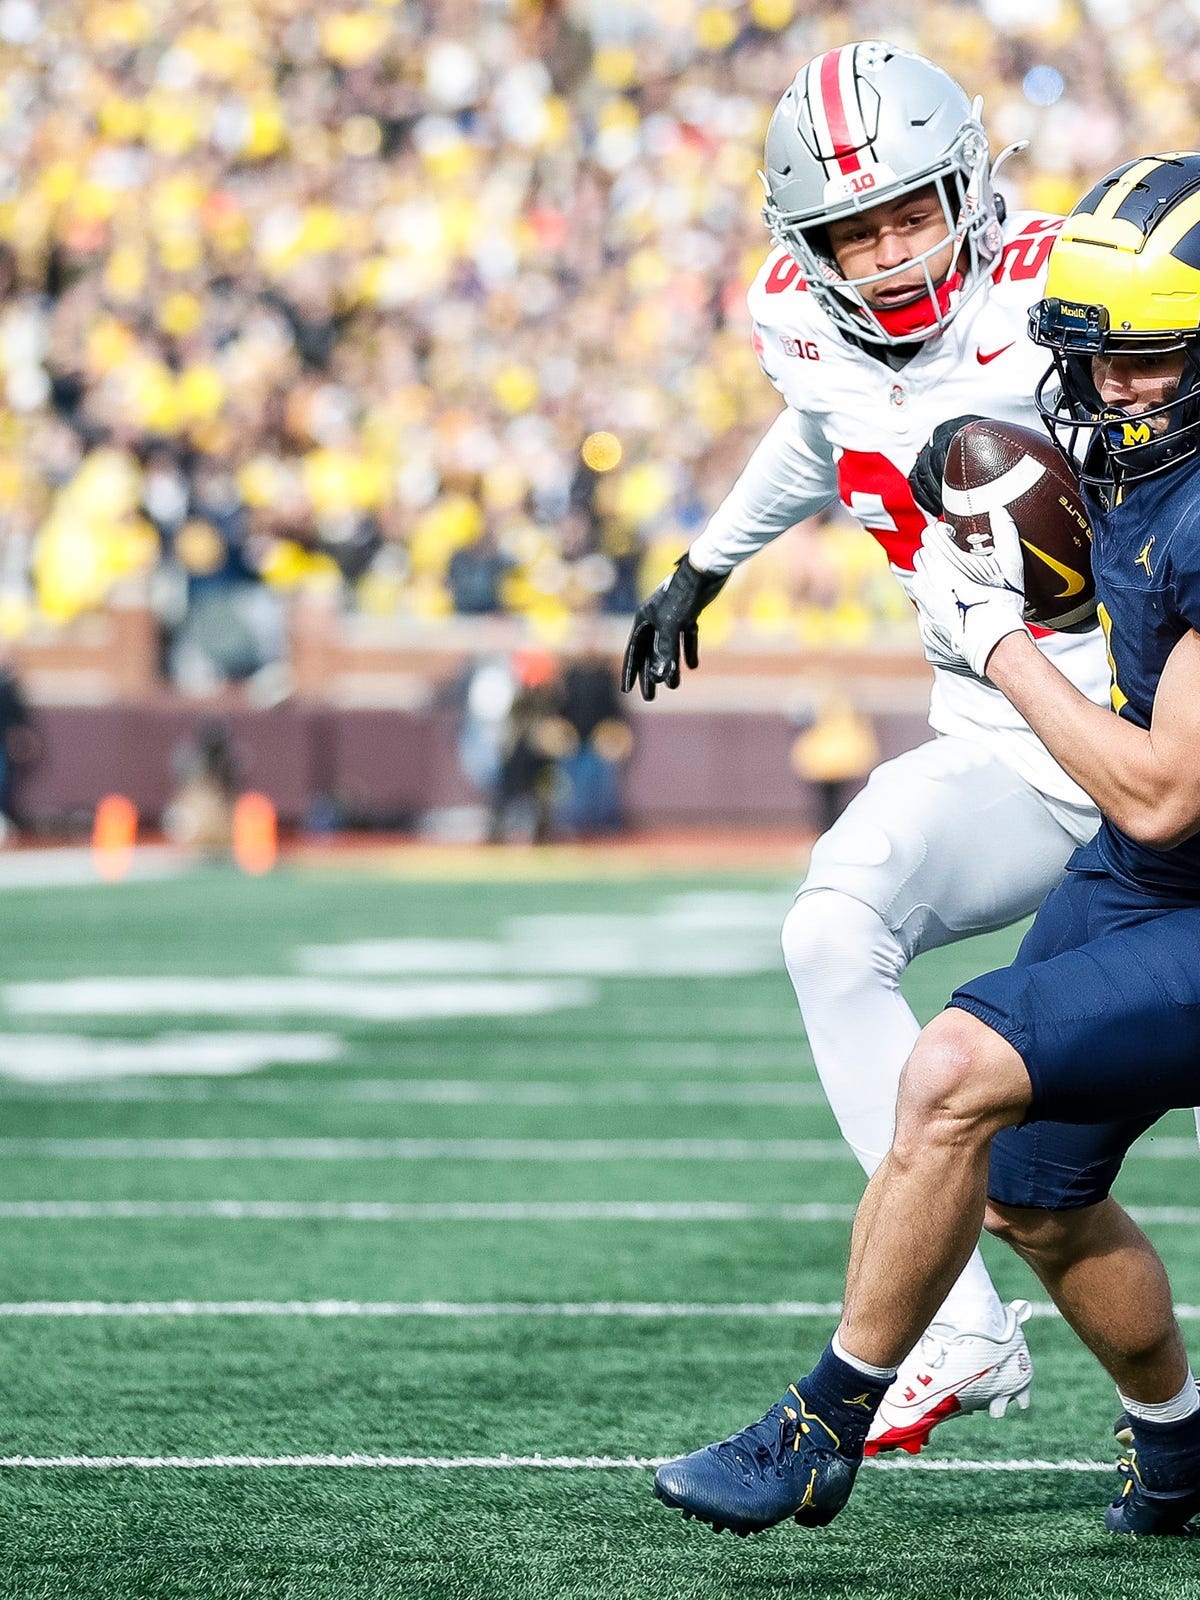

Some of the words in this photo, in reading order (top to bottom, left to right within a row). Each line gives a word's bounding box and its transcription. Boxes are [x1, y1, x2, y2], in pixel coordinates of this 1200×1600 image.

[1121, 422, 1150, 446] M
[838, 448, 931, 573] 2
[1058, 495, 1088, 529] ELITE
